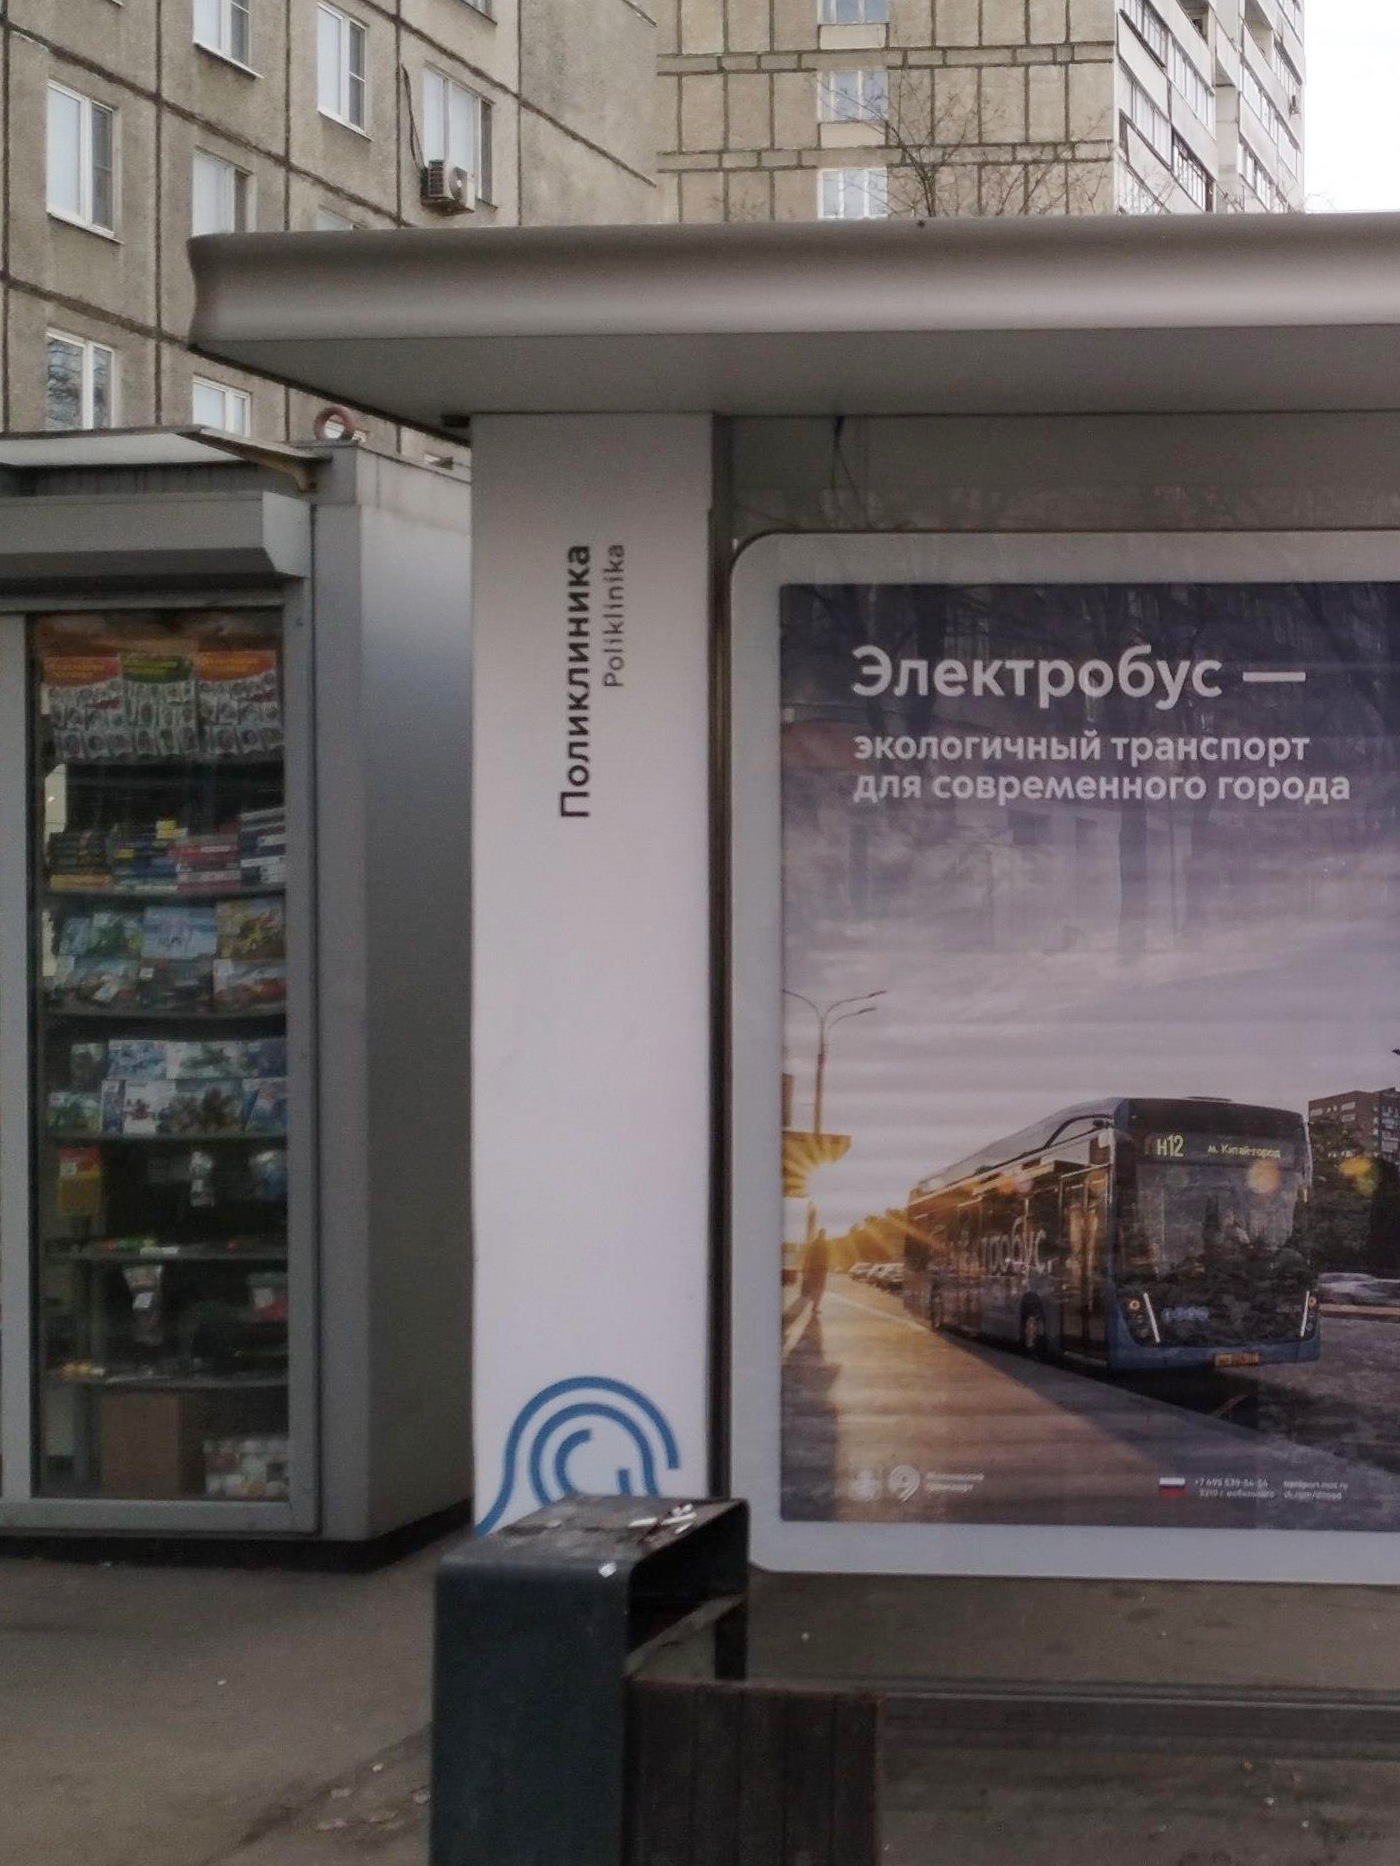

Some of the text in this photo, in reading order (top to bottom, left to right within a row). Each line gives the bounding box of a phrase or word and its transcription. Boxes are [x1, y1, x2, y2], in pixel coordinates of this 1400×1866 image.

[603, 544, 625, 687] Poliklinika
[559, 545, 590, 818] Поликлиника
[852, 644, 1223, 709] Электробус
[854, 728, 1310, 768] экологичный транспорт
[853, 774, 1350, 807] для современного города
